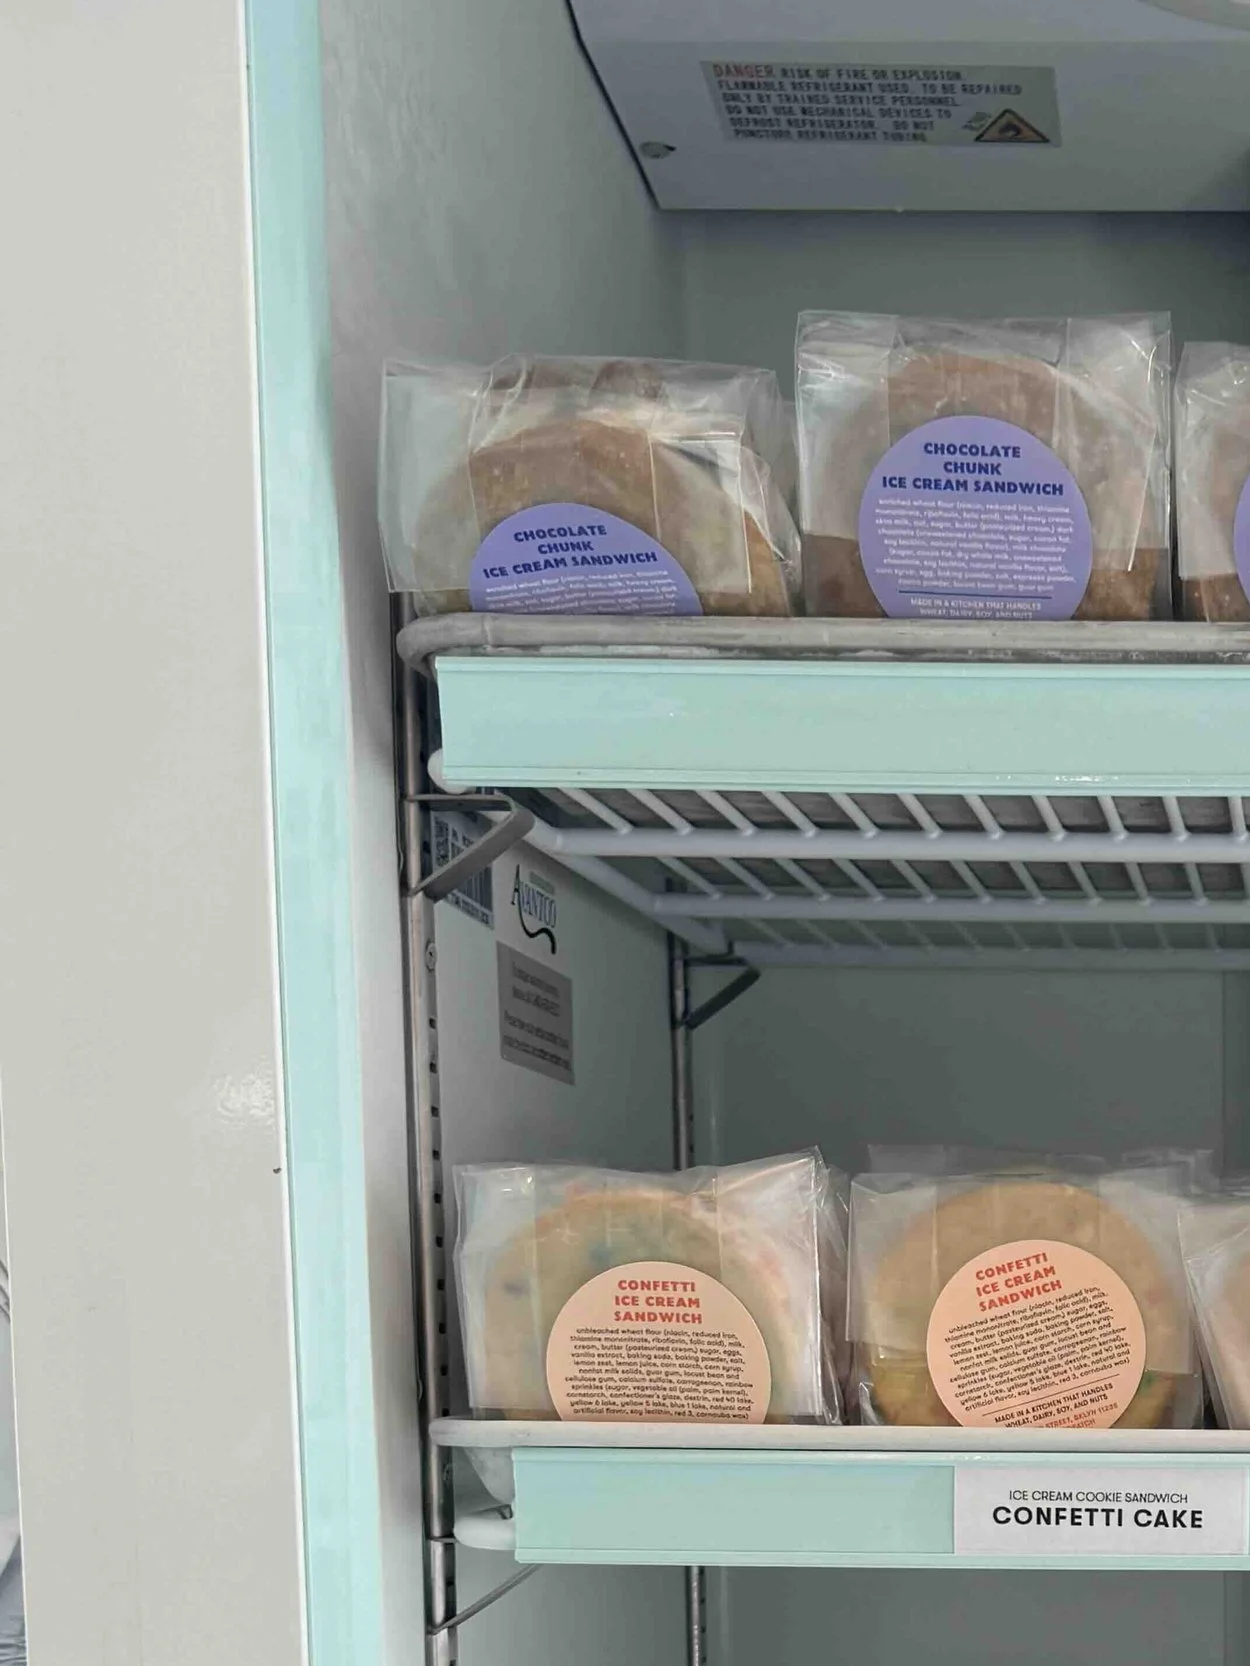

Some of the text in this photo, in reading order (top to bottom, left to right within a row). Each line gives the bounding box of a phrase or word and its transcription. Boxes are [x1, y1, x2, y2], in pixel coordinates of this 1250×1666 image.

[924, 443, 1021, 458] CHOCOLATE
[943, 461, 1002, 475] CHUNK
[882, 477, 1063, 495] ICE CREAM SANDWICH
[513, 525, 607, 542] CHOCOLATE
[538, 541, 594, 555] CHUNK
[483, 552, 658, 579] ICE CREAM SANDWICH
[975, 1253, 1048, 1281] CONFETTI
[618, 1280, 696, 1292] CONFETTI
[976, 1266, 1056, 1297] ICE CREAM
[615, 1296, 700, 1308] ICE CREAM
[979, 1280, 1062, 1312] SANDWICH
[614, 1311, 702, 1324] SANDWICH
[995, 1414, 1014, 1423] MADE
[1017, 1409, 1024, 1417] IN
[1032, 1400, 1062, 1412] KITCHEN
[1063, 1393, 1079, 1404] THAT
[1082, 1383, 1113, 1397] HANDLES
[1033, 1394, 1108, 1421] DAIRY, SOY, AND NUTS
[1010, 1490, 1187, 1503] ICE CREAM COOKIE SANDWICH
[993, 1506, 1203, 1528] CONFETTI CAKE
